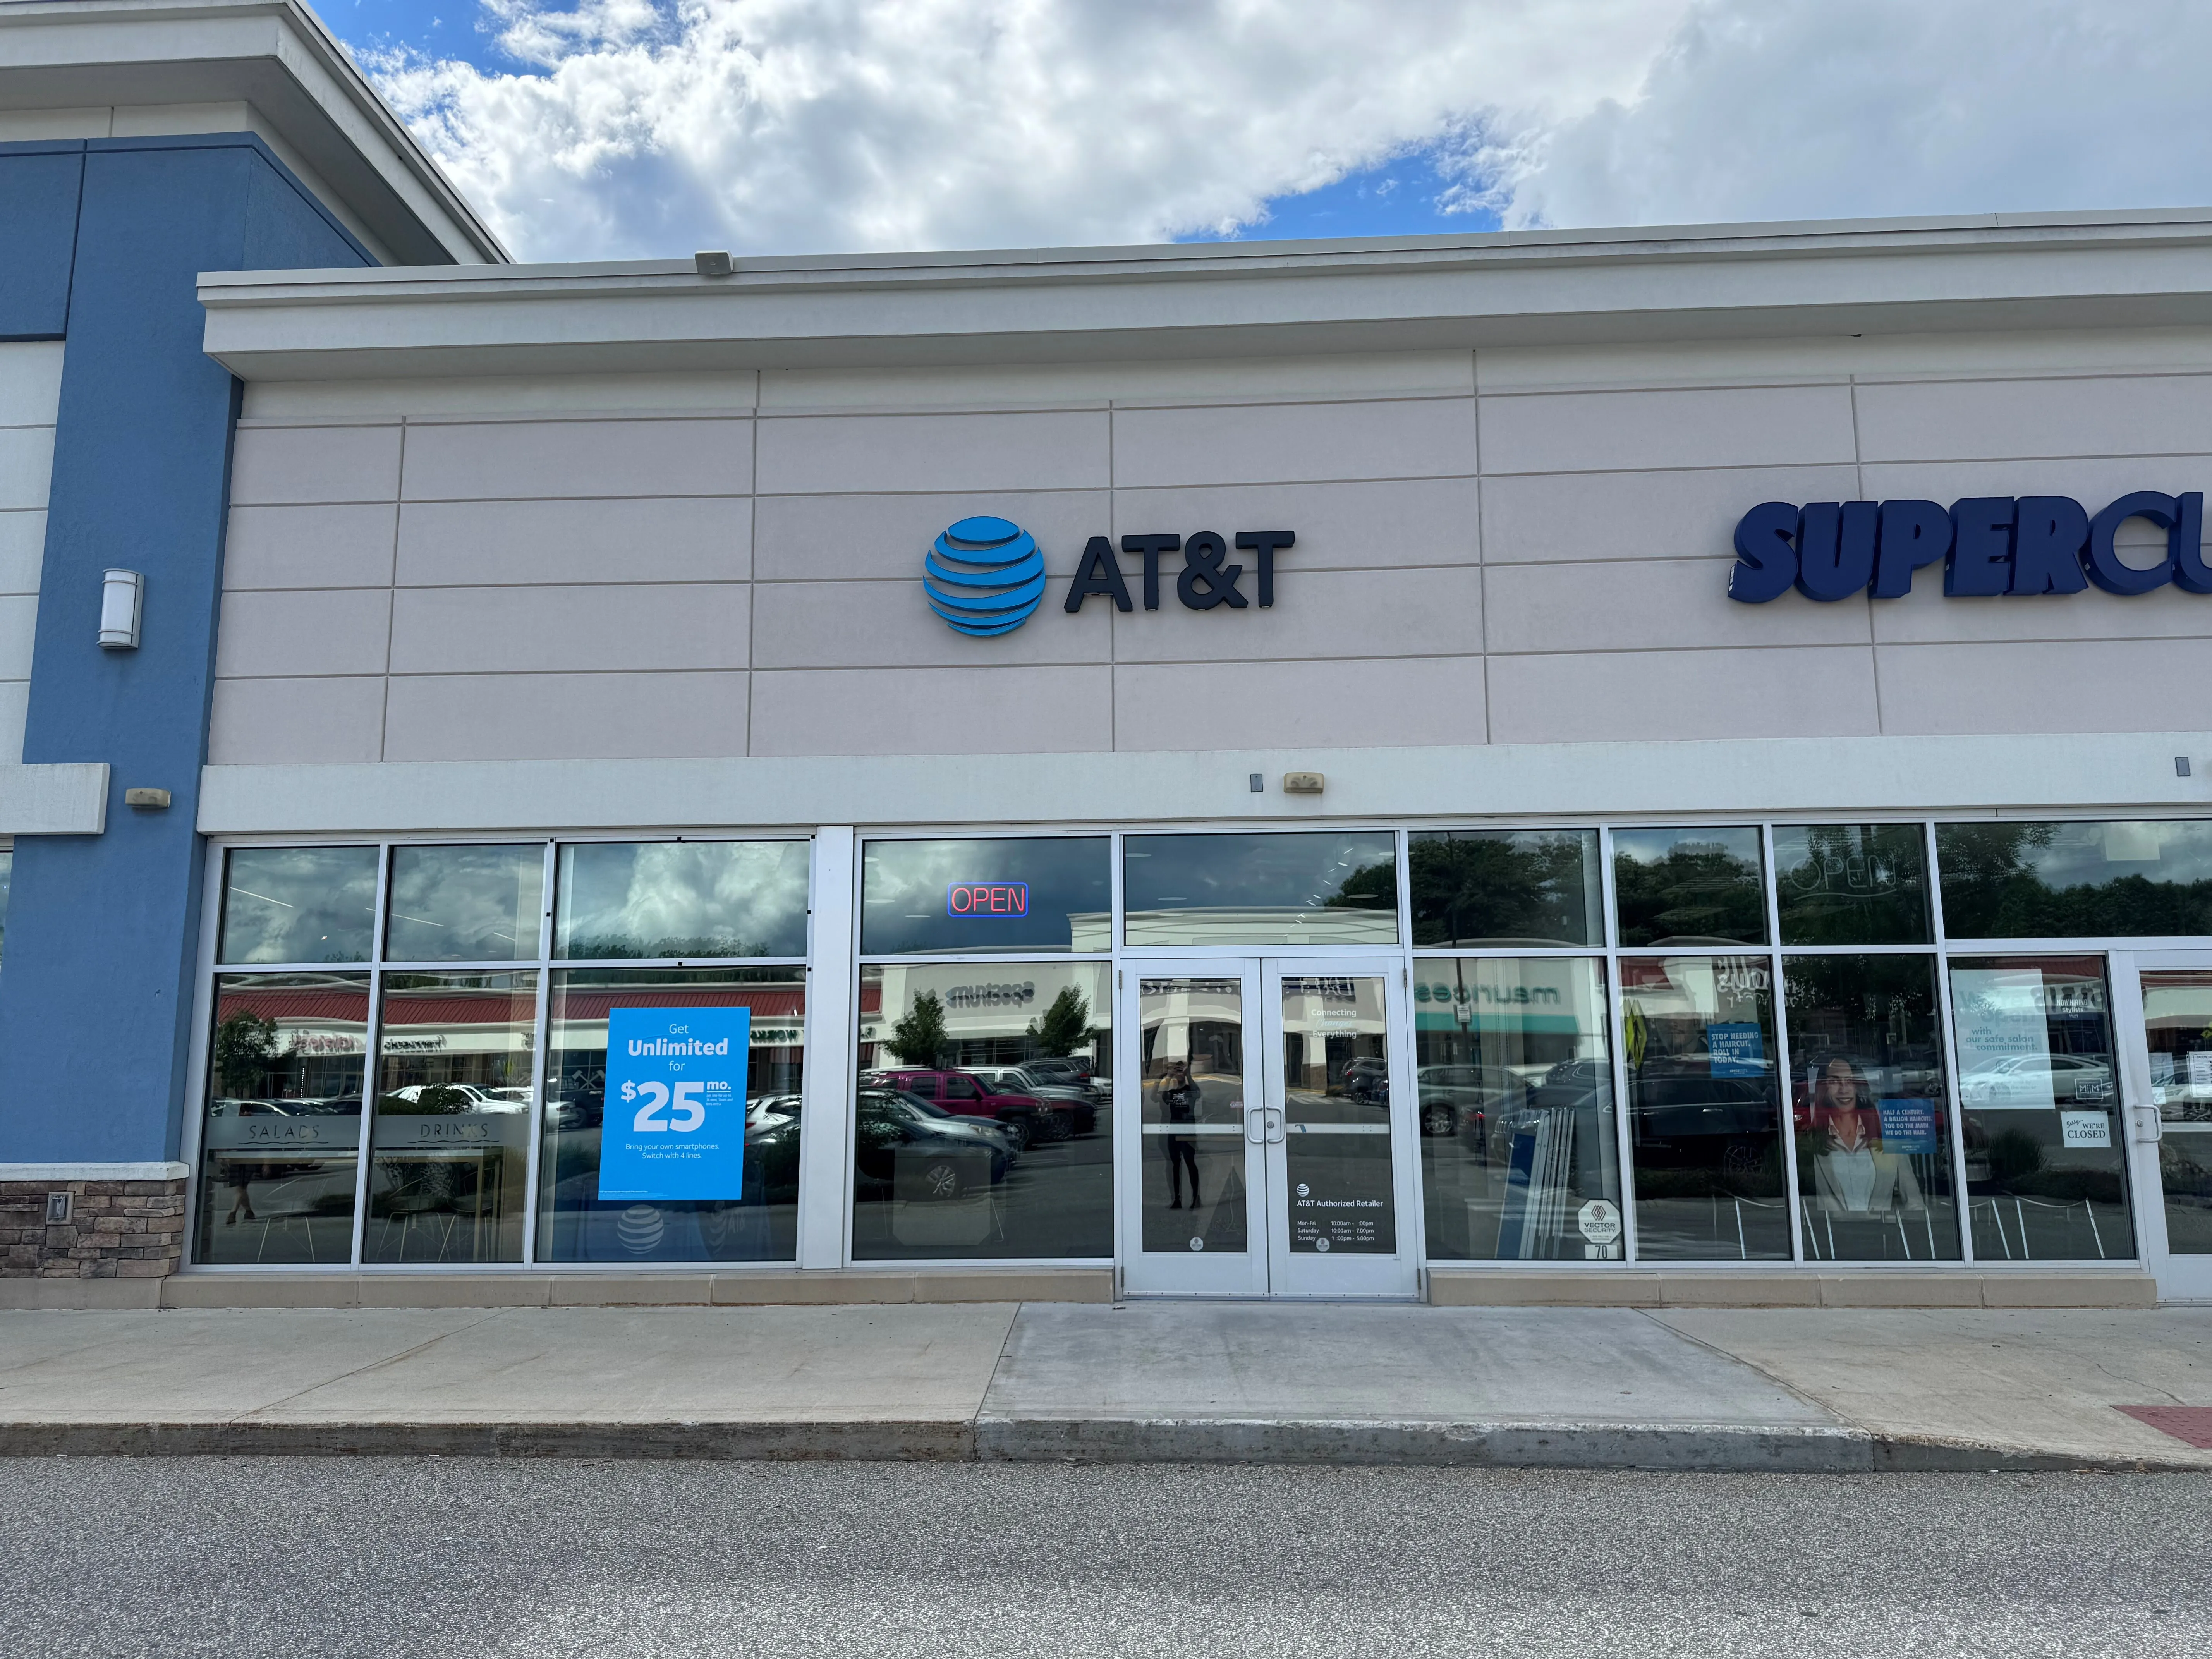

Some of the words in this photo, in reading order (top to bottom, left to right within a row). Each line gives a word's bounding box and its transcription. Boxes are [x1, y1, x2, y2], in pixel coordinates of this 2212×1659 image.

[1064, 531, 1295, 612] AT&T
[1790, 854, 1896, 890] OPEN
[951, 887, 1025, 912] OPEN
[1311, 1009, 1356, 1017] Connecting
[669, 1024, 689, 1034] Get
[1972, 1027, 1992, 1035] with
[1985, 1034, 2004, 1042] safe
[2008, 1034, 2033, 1042] salon
[628, 1038, 728, 1056] Unlimited
[669, 1060, 685, 1071] for
[620, 1079, 705, 1132] $25
[707, 1081, 731, 1090] mo.
[249, 1125, 320, 1139] SALADS
[420, 1123, 488, 1138] DRINKS
[2068, 1130, 2106, 1139] CLOSED
[1595, 1245, 1607, 1259] 70
